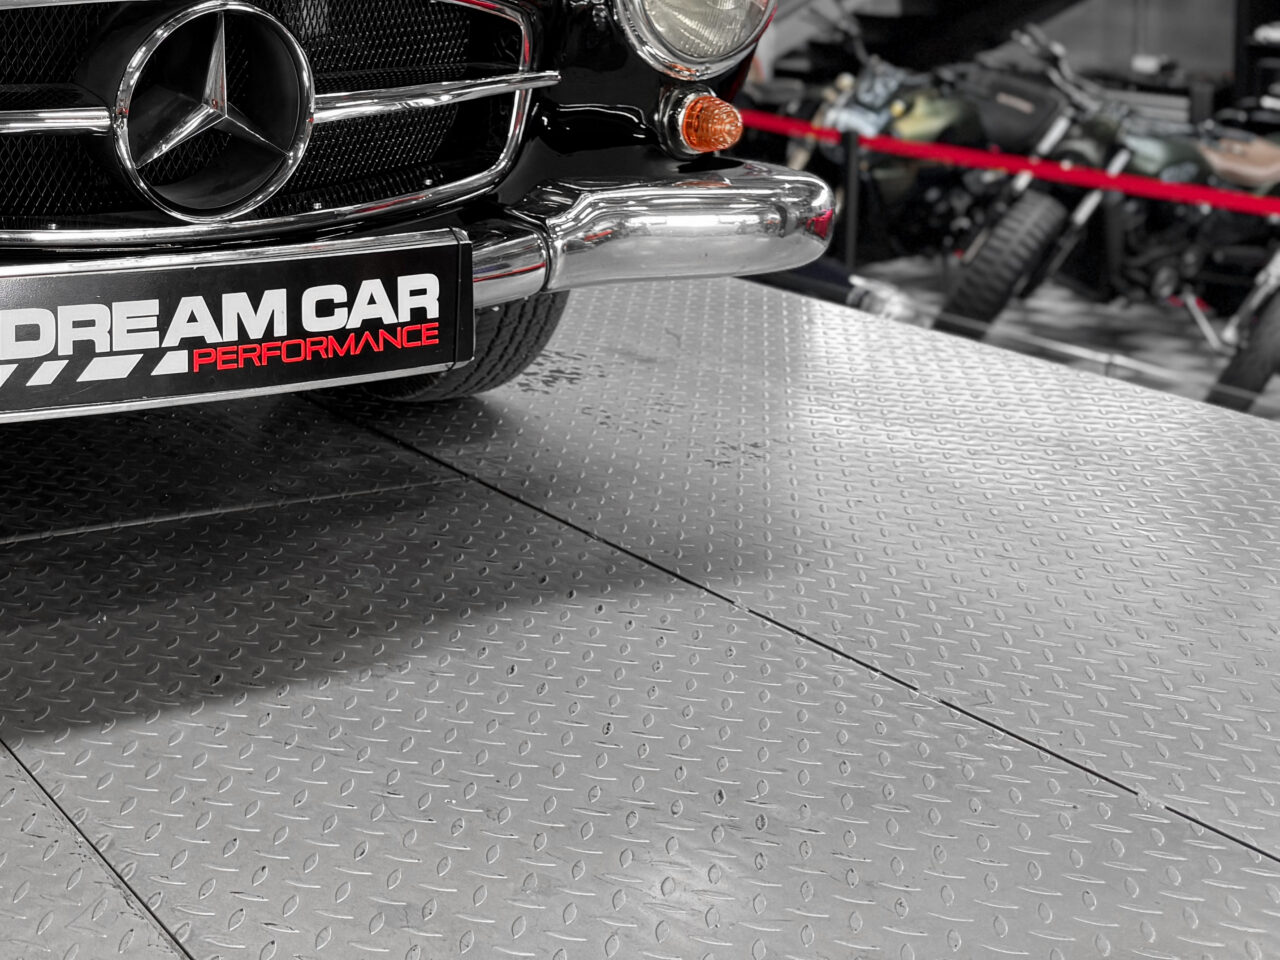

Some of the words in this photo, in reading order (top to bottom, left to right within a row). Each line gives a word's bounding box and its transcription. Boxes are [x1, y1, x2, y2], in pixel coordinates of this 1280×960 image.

[0, 289, 287, 361] DREAM
[301, 273, 439, 332] CAR
[193, 322, 439, 372] PERFORMANCE
